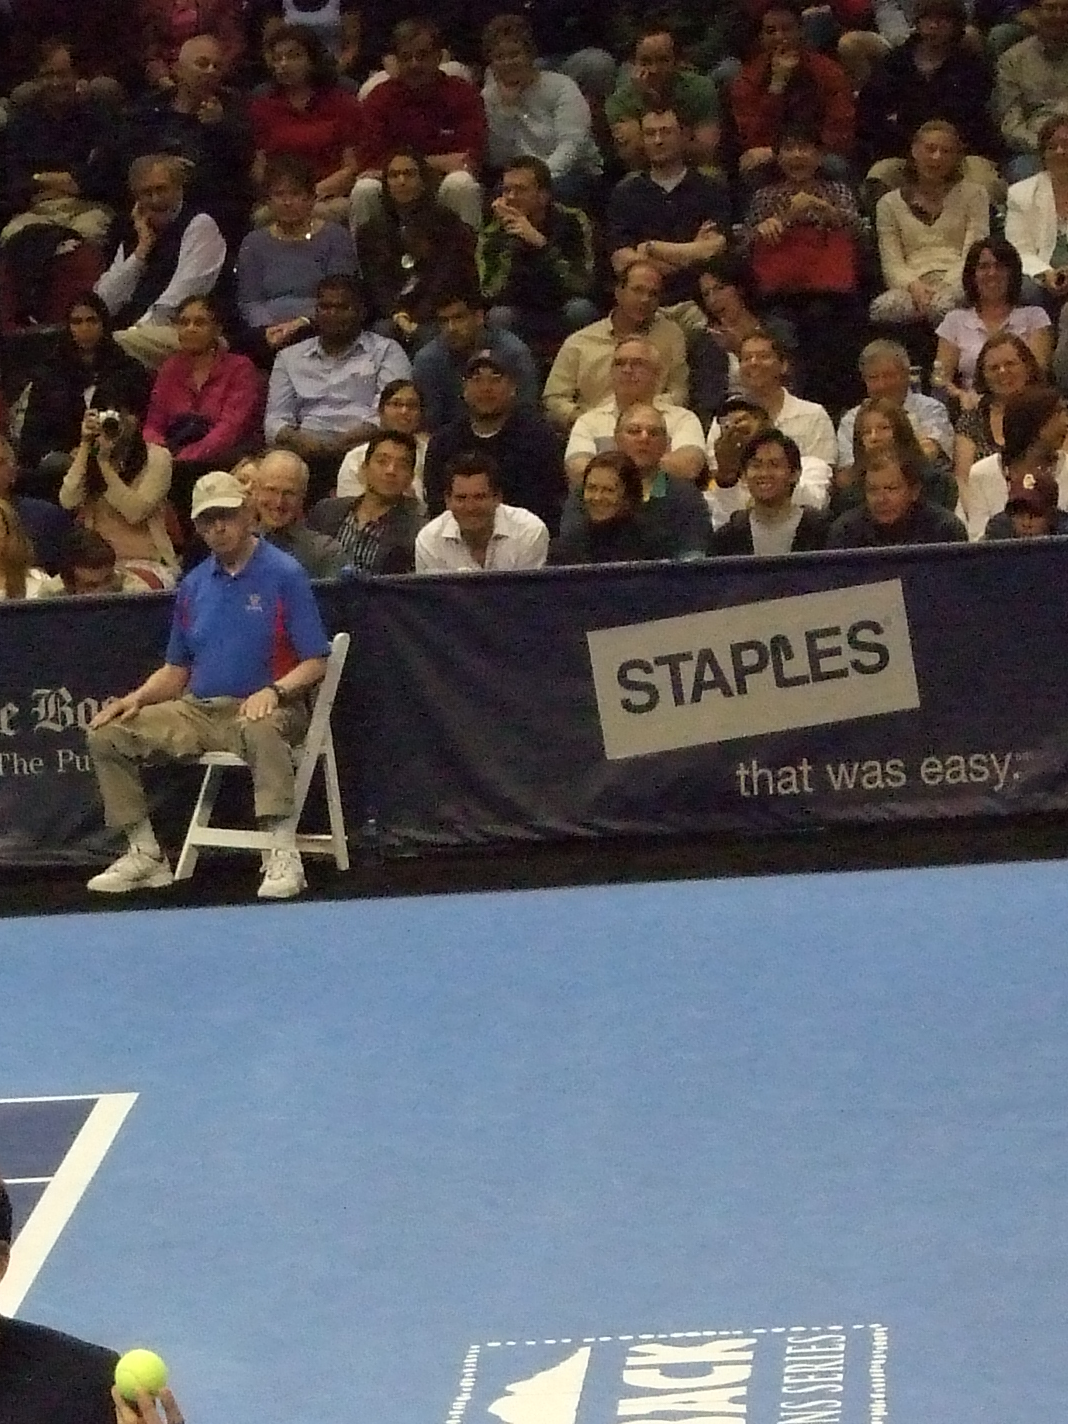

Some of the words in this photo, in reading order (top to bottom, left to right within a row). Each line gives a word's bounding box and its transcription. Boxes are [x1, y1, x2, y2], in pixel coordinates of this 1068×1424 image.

[616, 620, 890, 714] STAPLES
[56, 748, 90, 773] Pu
[736, 758, 813, 797] that
[826, 757, 907, 791] was
[781, 1334, 847, 1394] SERIES
